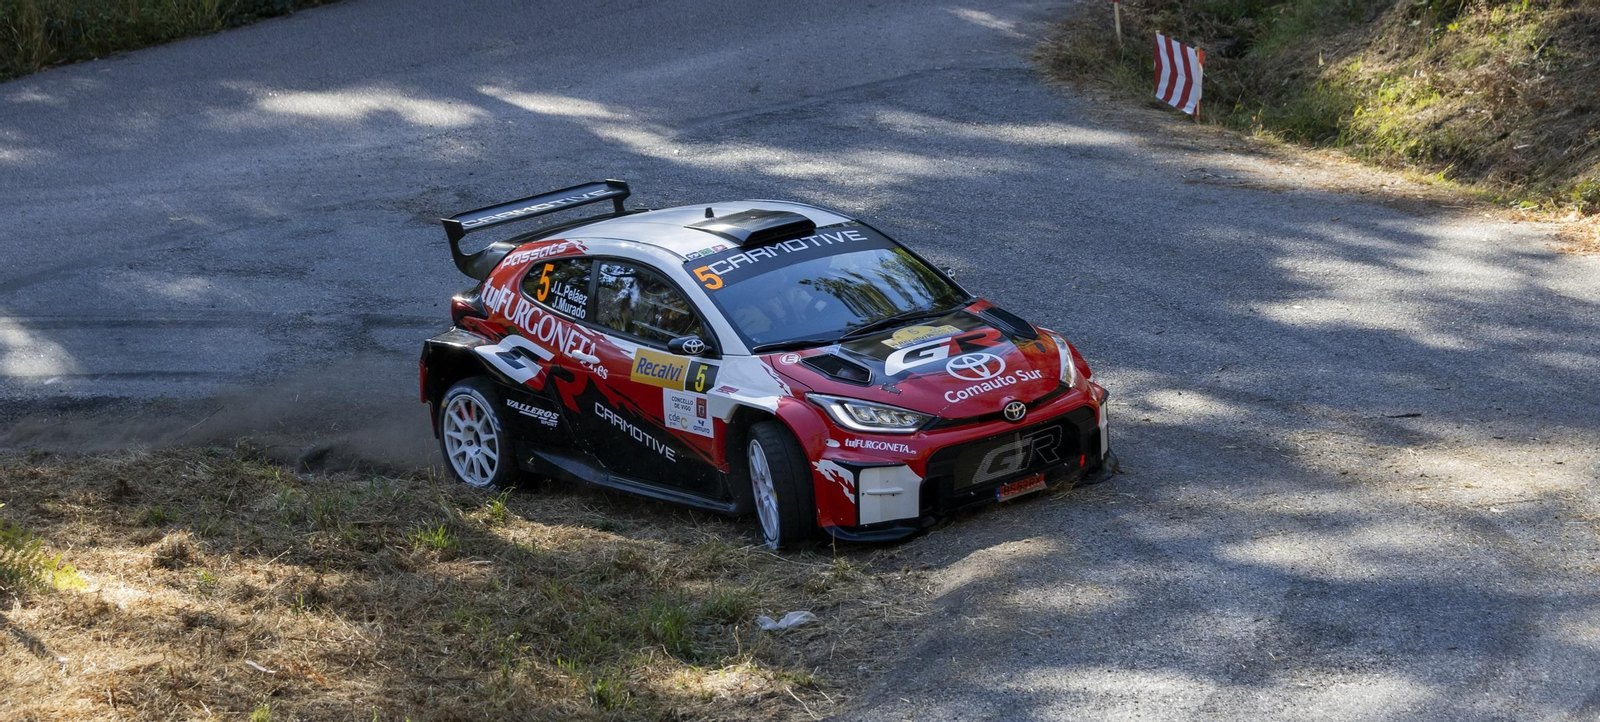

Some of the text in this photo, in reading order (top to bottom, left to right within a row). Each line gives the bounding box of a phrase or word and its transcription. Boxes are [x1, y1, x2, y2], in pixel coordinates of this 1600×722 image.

[462, 189, 614, 227] CARMOTIVE
[708, 230, 868, 276] CARMOTIVE
[536, 263, 555, 302] 5
[693, 265, 724, 290] 5
[885, 327, 1002, 377] GR
[636, 357, 709, 392] Recalvi 5
[944, 368, 1043, 404] Comauto Sur
[506, 399, 560, 420] VALLEROS
[671, 395, 694, 406] CONCELLO
[594, 401, 677, 463] CARMOTIVE
[972, 424, 1063, 485] GR
